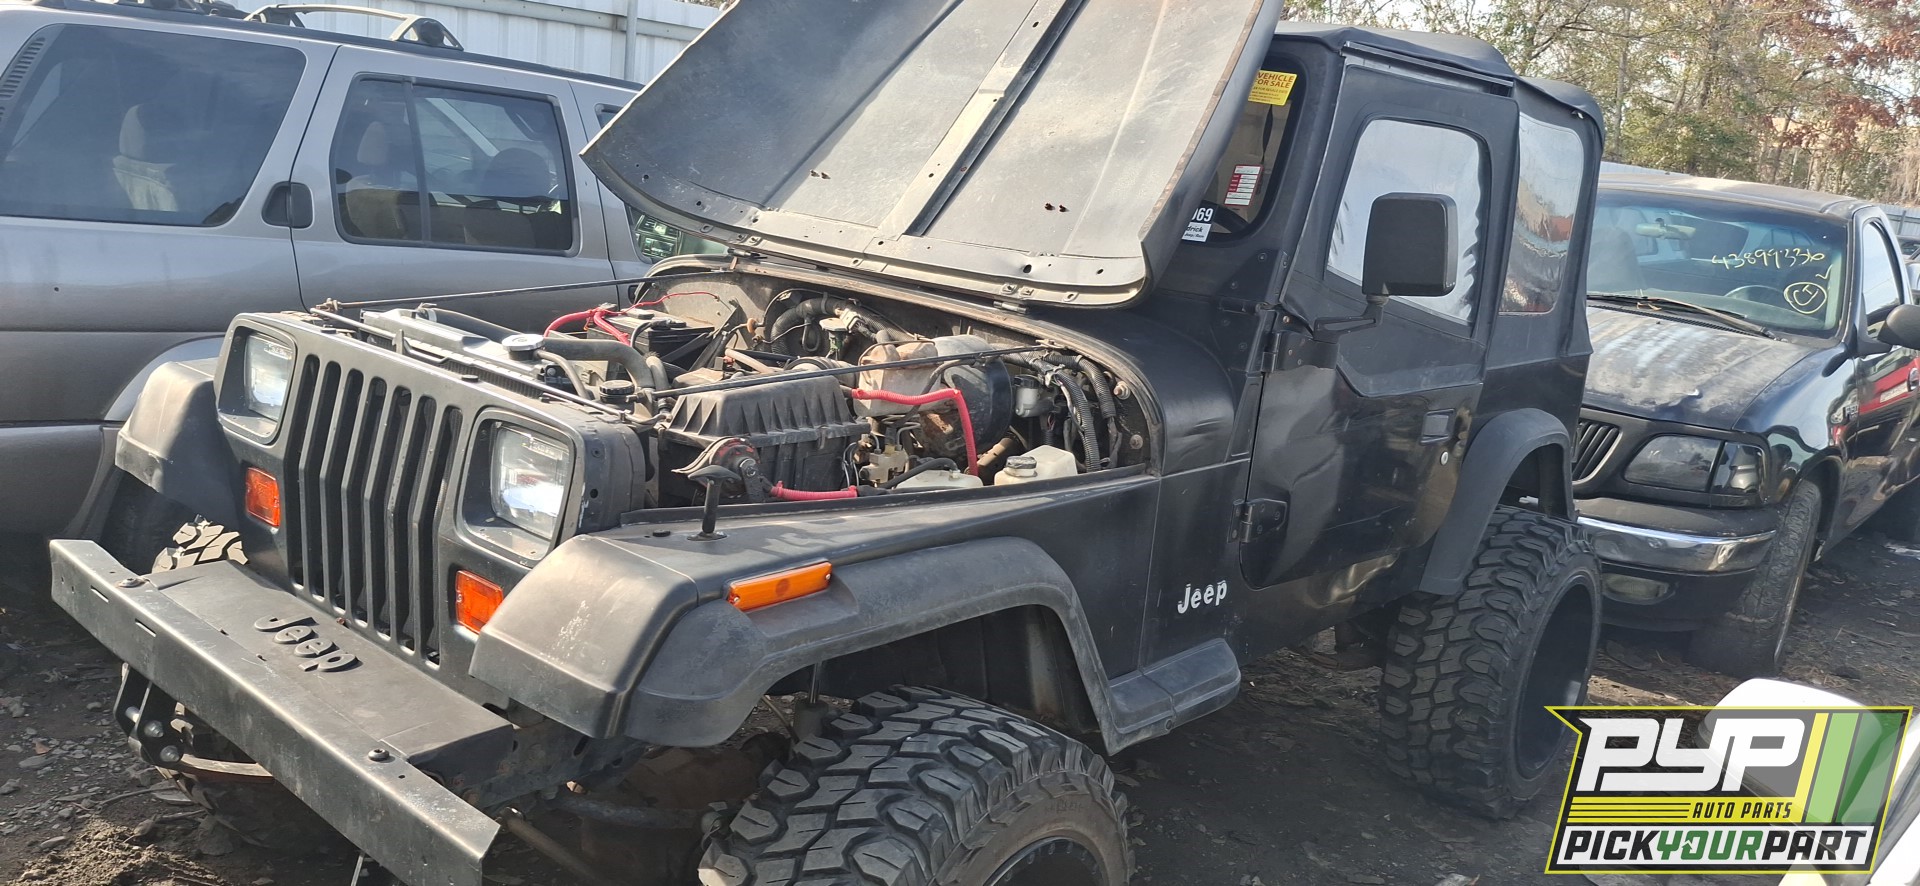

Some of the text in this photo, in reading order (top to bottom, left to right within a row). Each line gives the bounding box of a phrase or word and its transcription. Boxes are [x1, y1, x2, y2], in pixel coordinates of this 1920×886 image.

[1258, 72, 1294, 82] VEHICLE
[1270, 80, 1291, 88] SALE
[1177, 579, 1227, 614] Jeep
[254, 616, 358, 673] Jeep
